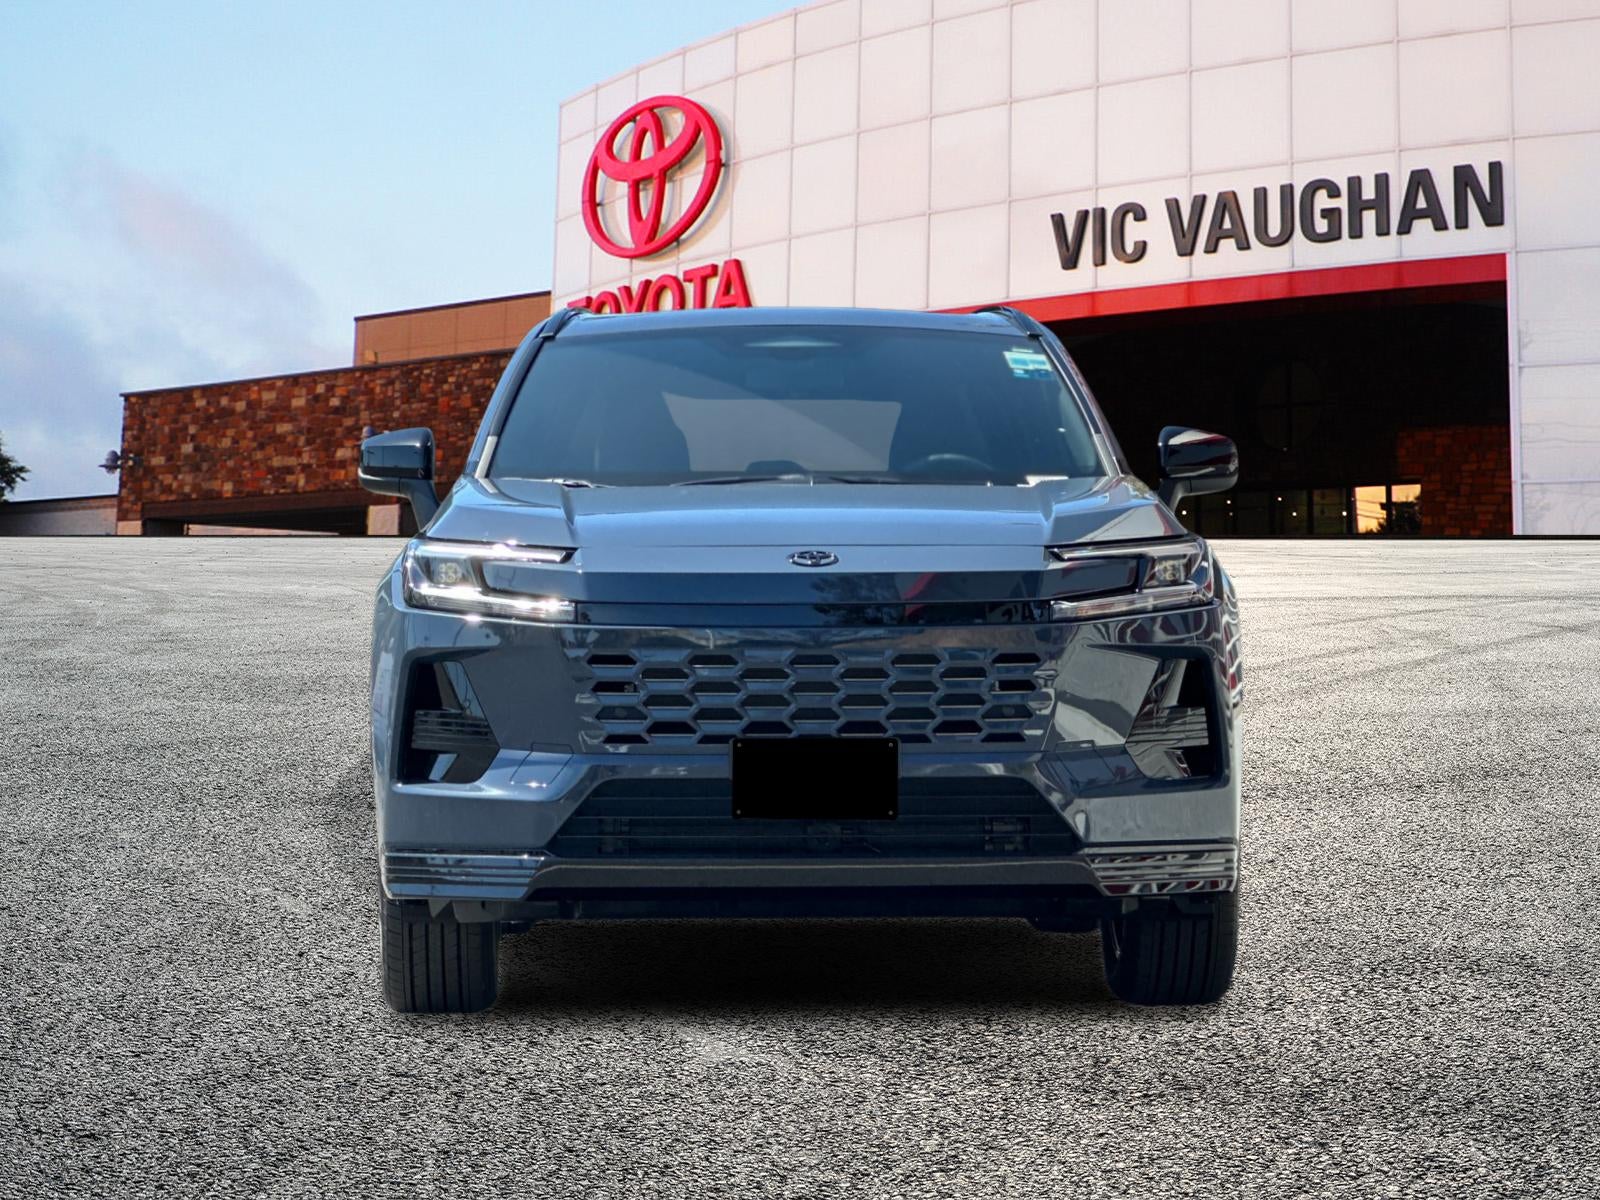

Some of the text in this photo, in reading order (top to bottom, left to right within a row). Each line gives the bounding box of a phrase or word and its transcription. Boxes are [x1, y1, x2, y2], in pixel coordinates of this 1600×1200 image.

[1050, 160, 1505, 270] VIC VAUGHAN
[567, 258, 752, 314] OYOTA
